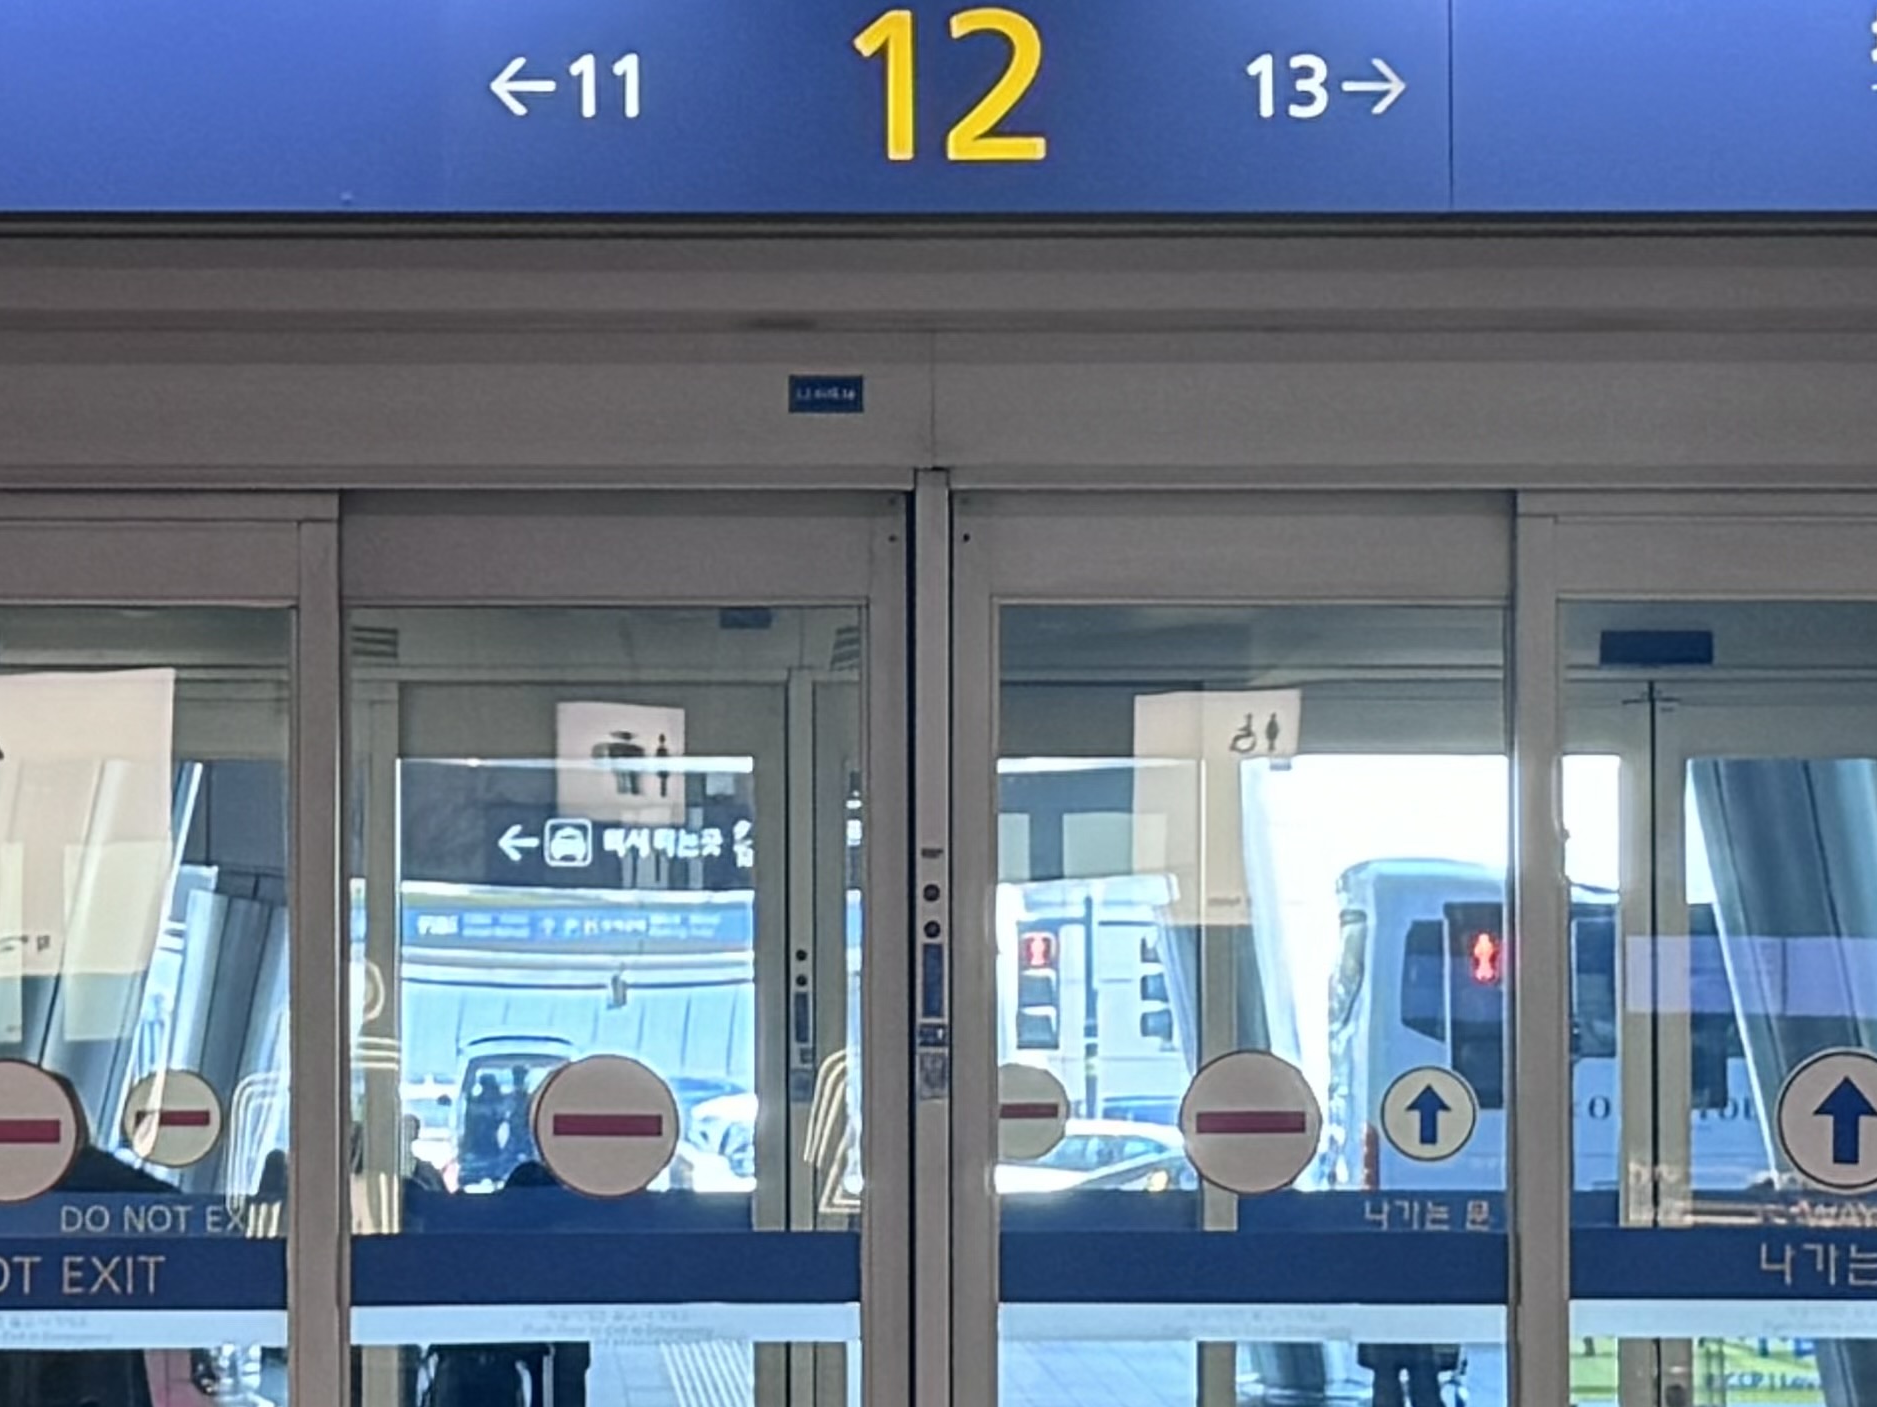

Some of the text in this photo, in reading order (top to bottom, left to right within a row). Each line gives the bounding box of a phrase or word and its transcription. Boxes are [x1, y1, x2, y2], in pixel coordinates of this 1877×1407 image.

[569, 53, 639, 118] 11
[853, 7, 1046, 161] 12
[1246, 53, 1329, 118] 13
[60, 1205, 110, 1233] DO
[123, 1205, 192, 1233] NOT
[62, 1255, 166, 1294] EXIT
